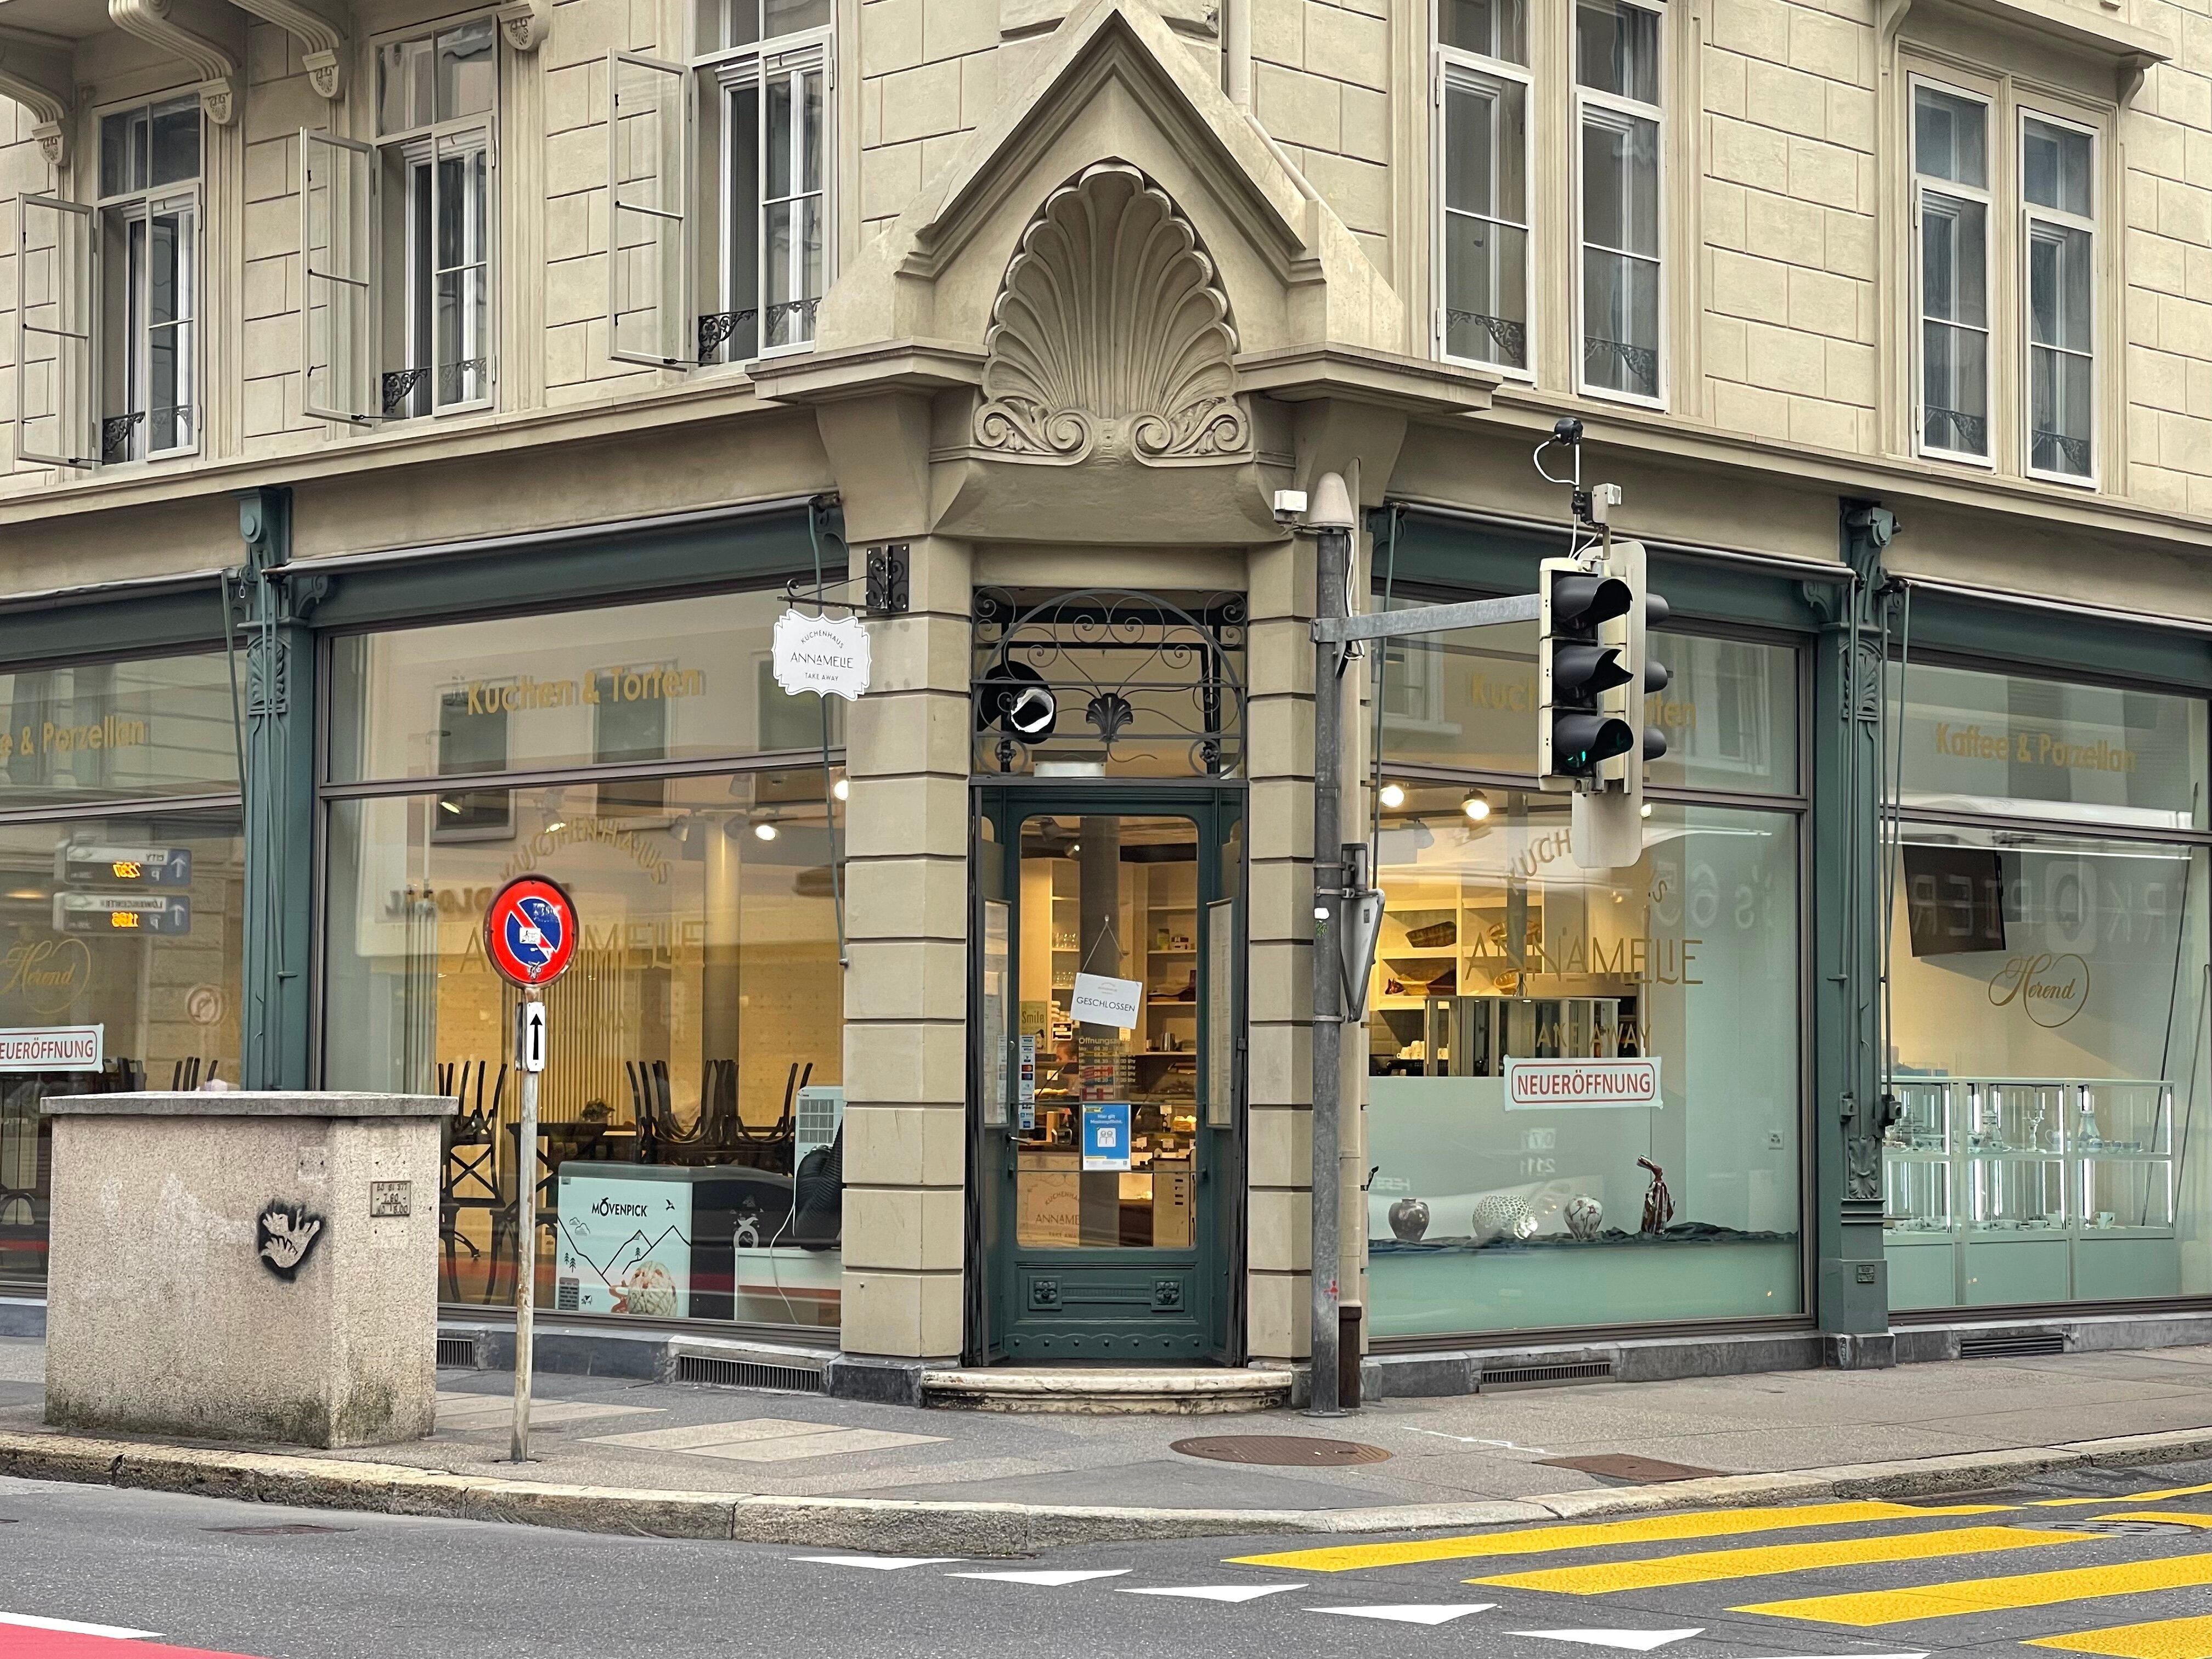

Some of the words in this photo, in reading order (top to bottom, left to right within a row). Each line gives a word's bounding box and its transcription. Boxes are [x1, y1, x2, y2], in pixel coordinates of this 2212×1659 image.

[801, 630, 844, 649] KUCHENHAUS
[467, 675, 576, 715] Kuchen
[582, 669, 601, 704] &
[611, 664, 701, 702] Torten
[20, 726, 35, 755] &
[43, 715, 146, 754] Porzellan
[1936, 723, 2009, 761] Kaffee
[2016, 732, 2032, 763] &
[2039, 732, 2137, 773] Porzellan
[1988, 953, 2090, 1028] Herend
[1022, 1011, 1045, 1024] Smile
[1076, 997, 1136, 1012] GESCHLOSSEN
[1525, 1022, 1579, 1049] TAKE
[1590, 1023, 1651, 1049] AWAY
[1517, 1069, 1650, 1096] NEUERÖFFNUNG
